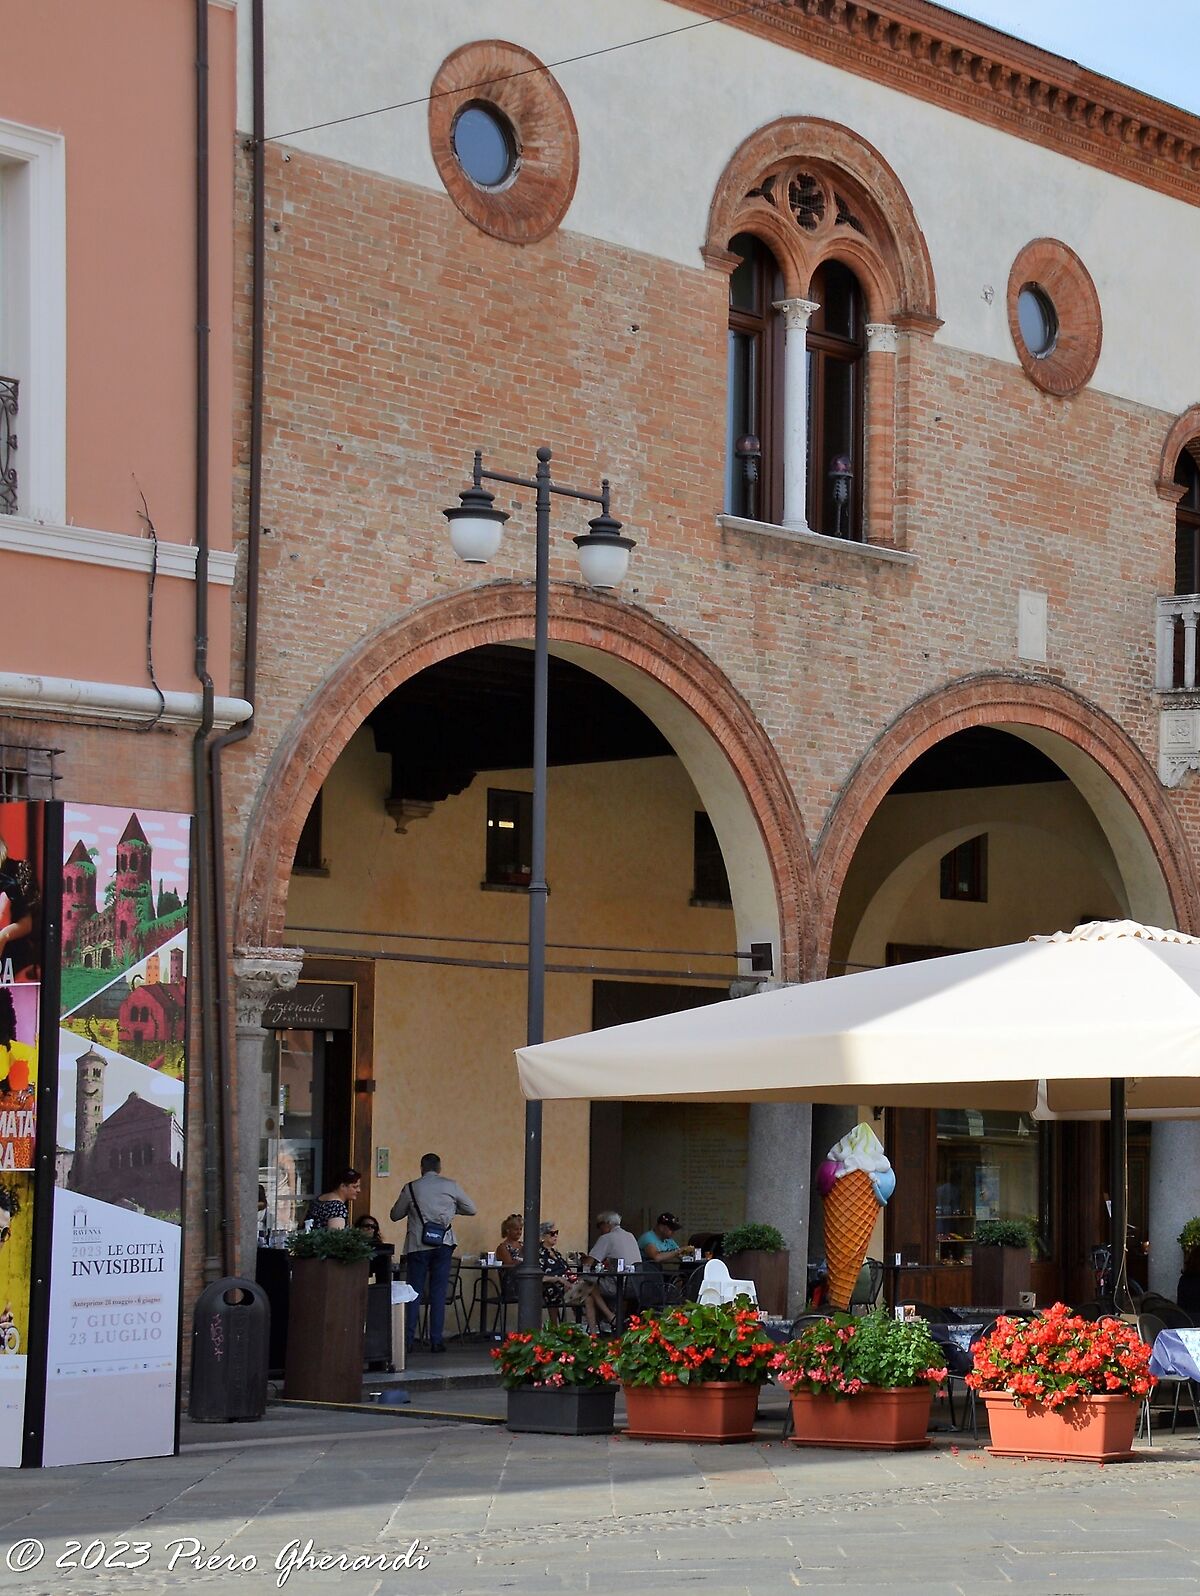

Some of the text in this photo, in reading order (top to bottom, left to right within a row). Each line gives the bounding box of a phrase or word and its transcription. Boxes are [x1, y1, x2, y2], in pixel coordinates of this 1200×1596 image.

[265, 994, 326, 1023] azionale
[72, 1240, 164, 1258] 2023 LE CITTÀ
[72, 1258, 164, 1277] INVISIBILI
[71, 1311, 162, 1329] 7 GIUGNO
[69, 1327, 162, 1346] 23 LUGLIO
